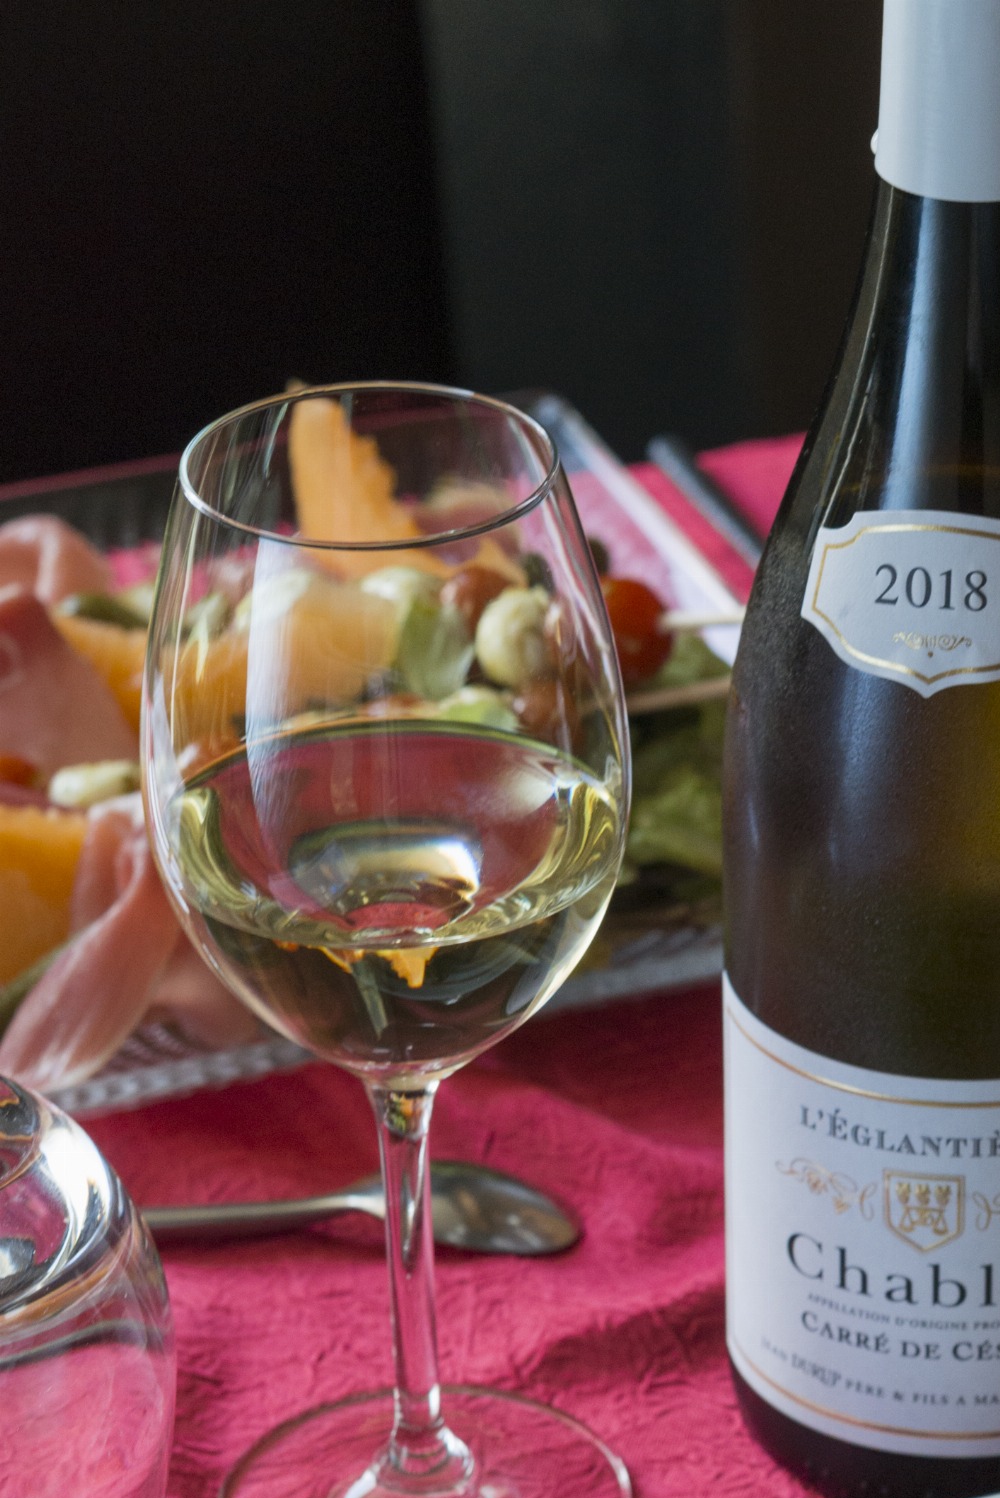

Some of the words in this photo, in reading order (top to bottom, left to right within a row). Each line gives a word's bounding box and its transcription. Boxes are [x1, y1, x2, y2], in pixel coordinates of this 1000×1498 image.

[874, 563, 988, 612] 2018
[808, 1292, 890, 1324] APPELLATION
[895, 1315, 968, 1332] D'ORIGINE
[801, 1310, 890, 1355] CARRÉ
[901, 1341, 942, 1361] DE
[892, 1389, 903, 1401] &
[911, 1391, 949, 1406] FILS
